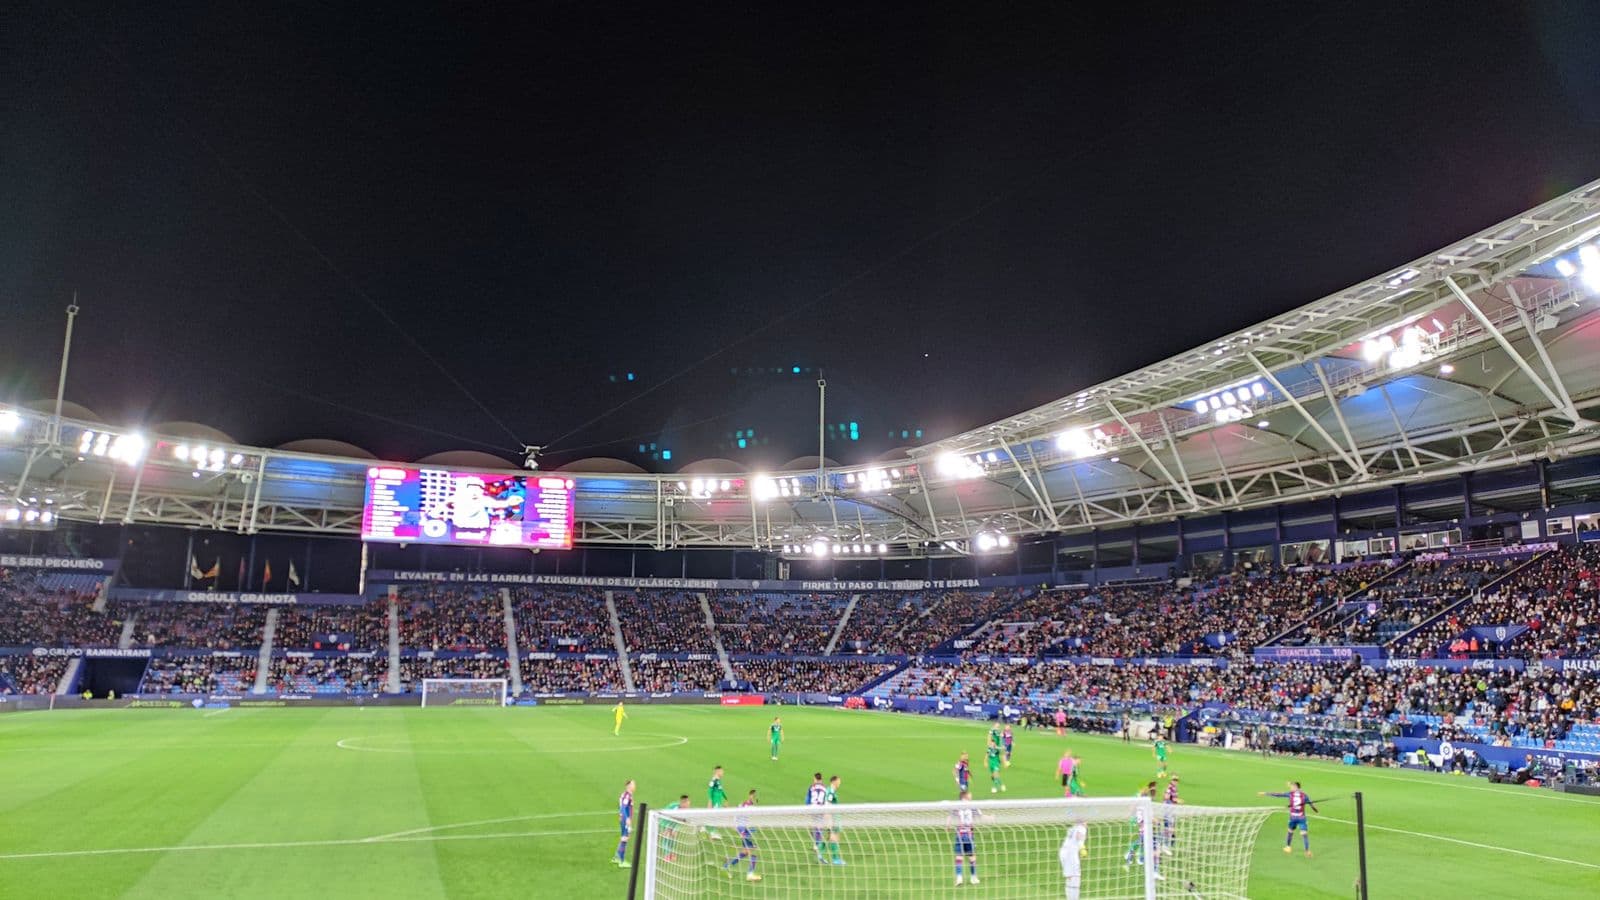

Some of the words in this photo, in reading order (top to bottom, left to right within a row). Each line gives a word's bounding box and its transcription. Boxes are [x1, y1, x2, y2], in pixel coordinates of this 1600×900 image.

[20, 557, 42, 566] SER
[46, 557, 104, 569] PEQUEÑO
[394, 571, 446, 581] LEVANTE,
[450, 573, 464, 581] EN
[468, 573, 488, 582] LAS
[491, 574, 533, 583] BARRAS
[536, 575, 604, 586] AZULGRANAS
[683, 580, 718, 589] JERSEY
[802, 582, 831, 590] FIRME
[834, 582, 846, 590] TU
[849, 582, 873, 590] PASO
[878, 581, 889, 590] EL
[188, 592, 237, 602] ORGULL
[240, 593, 296, 604] GRANOTA
[49, 648, 82, 656] GRUPO
[86, 648, 152, 657] RAMINATRANS
